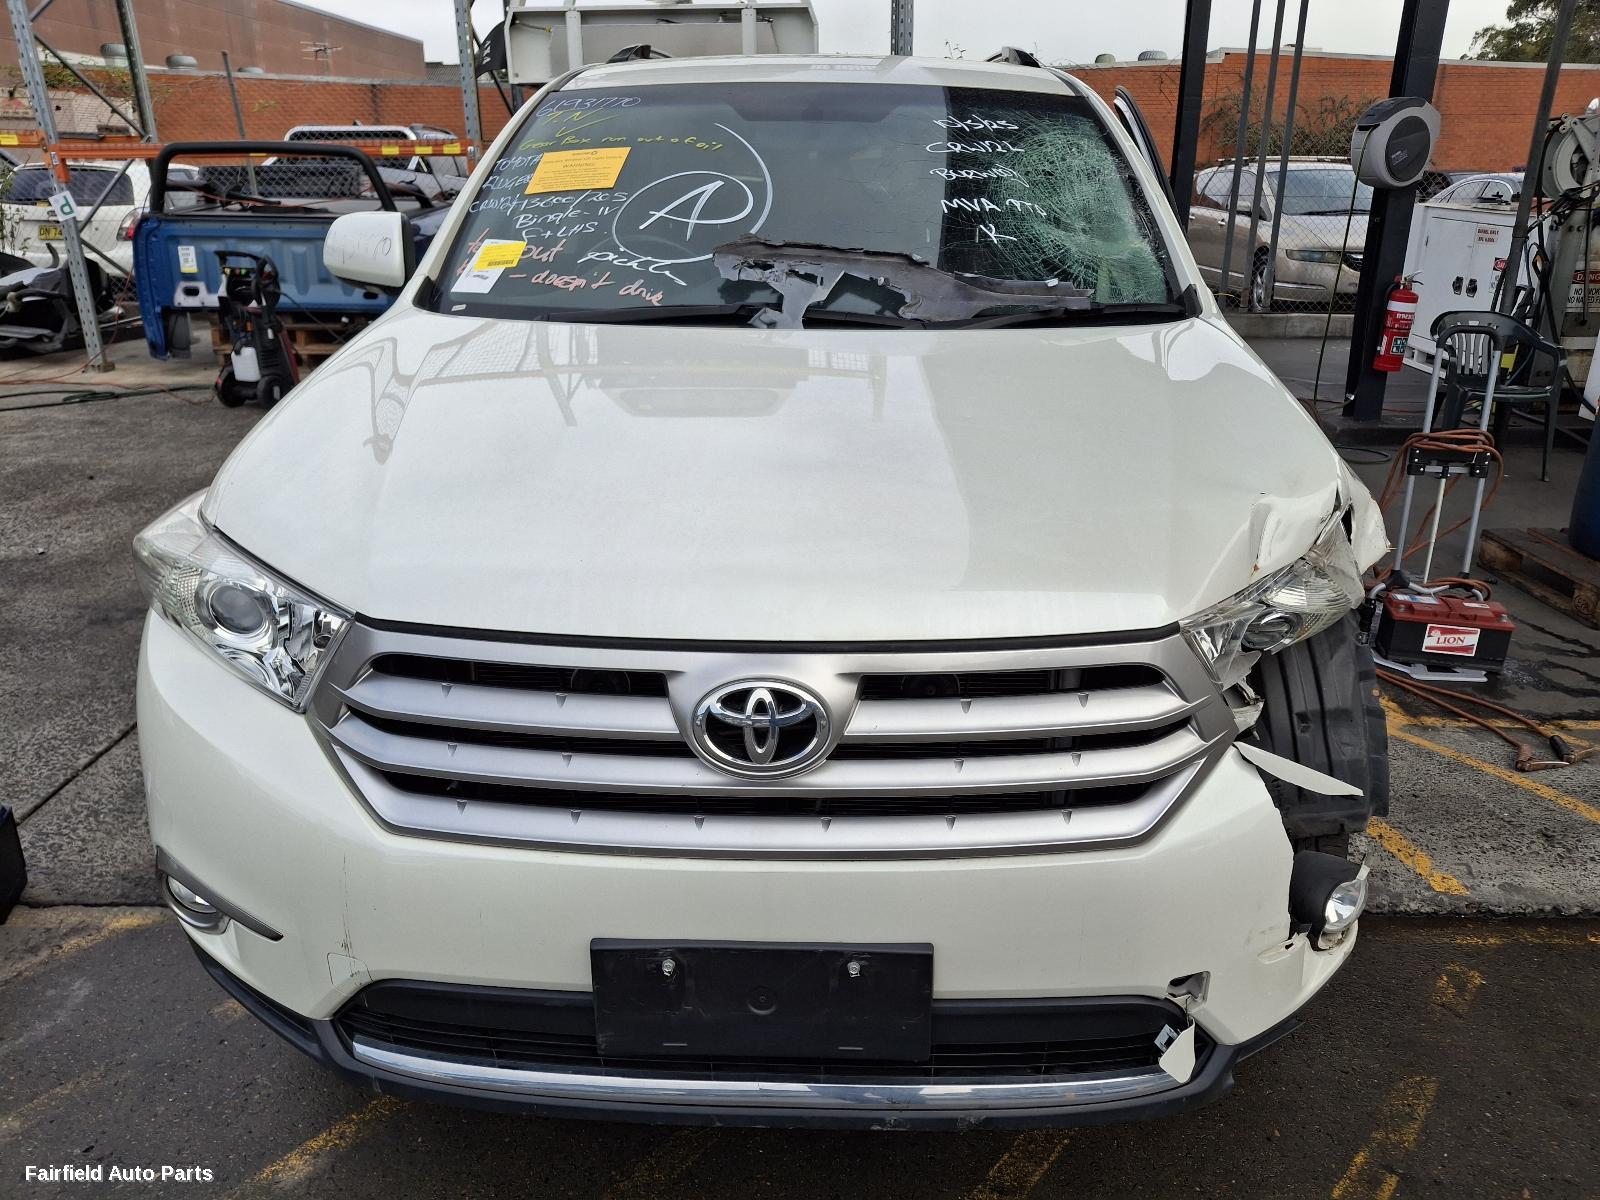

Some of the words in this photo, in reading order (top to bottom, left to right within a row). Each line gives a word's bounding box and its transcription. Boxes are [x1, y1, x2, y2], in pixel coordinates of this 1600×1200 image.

[637, 135, 665, 143] out
[940, 197, 1002, 214] MVA
[1576, 273, 1600, 283] DNG
[1436, 636, 1466, 645] LION
